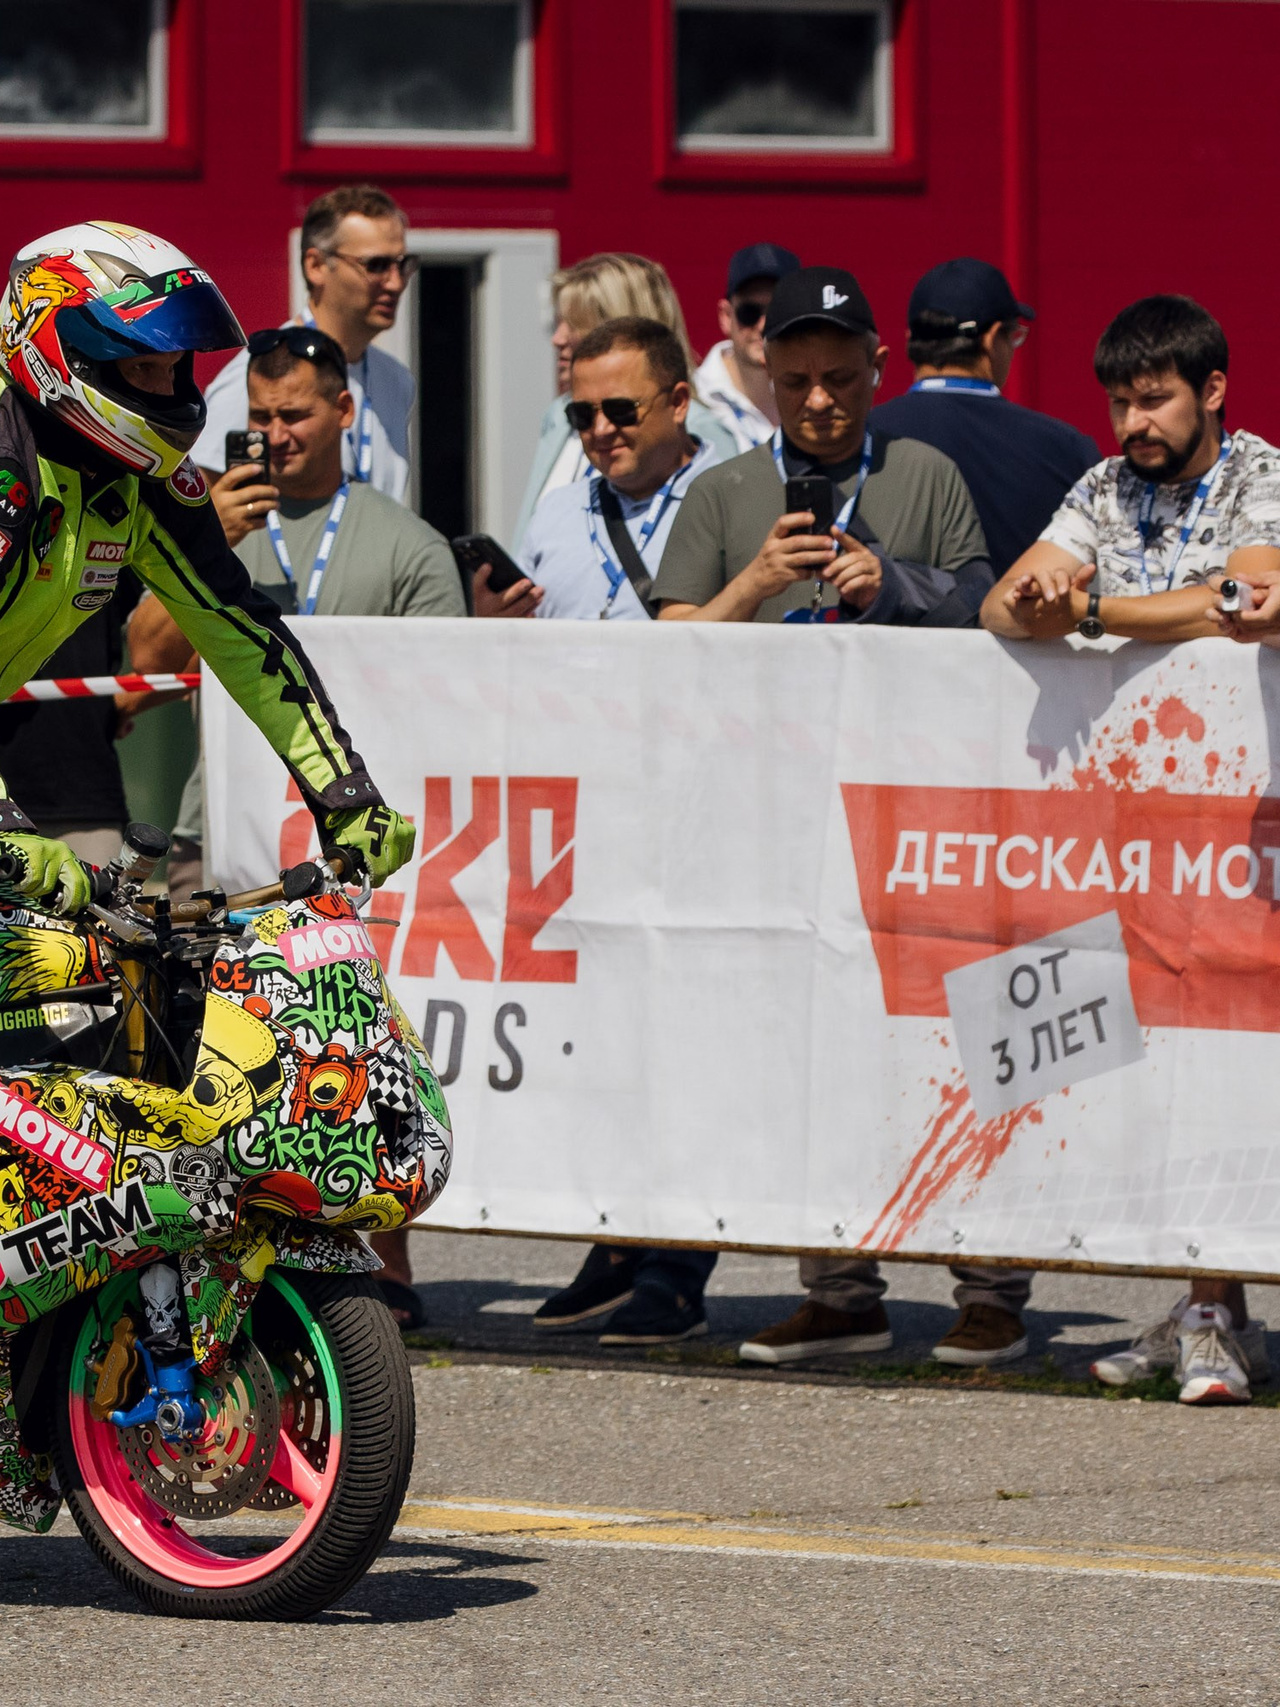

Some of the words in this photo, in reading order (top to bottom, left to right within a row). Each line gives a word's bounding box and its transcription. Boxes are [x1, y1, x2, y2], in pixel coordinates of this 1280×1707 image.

[164, 270, 193, 293] AG
[885, 829, 1152, 895] ДЕТСКАЯ
[1008, 949, 1070, 1010] ОТ
[991, 1038, 1016, 1086] 3
[1029, 996, 1109, 1072] ЛЕТ
[1, 1180, 153, 1276] TEAM
[365, 1196, 395, 1209] RACERS
